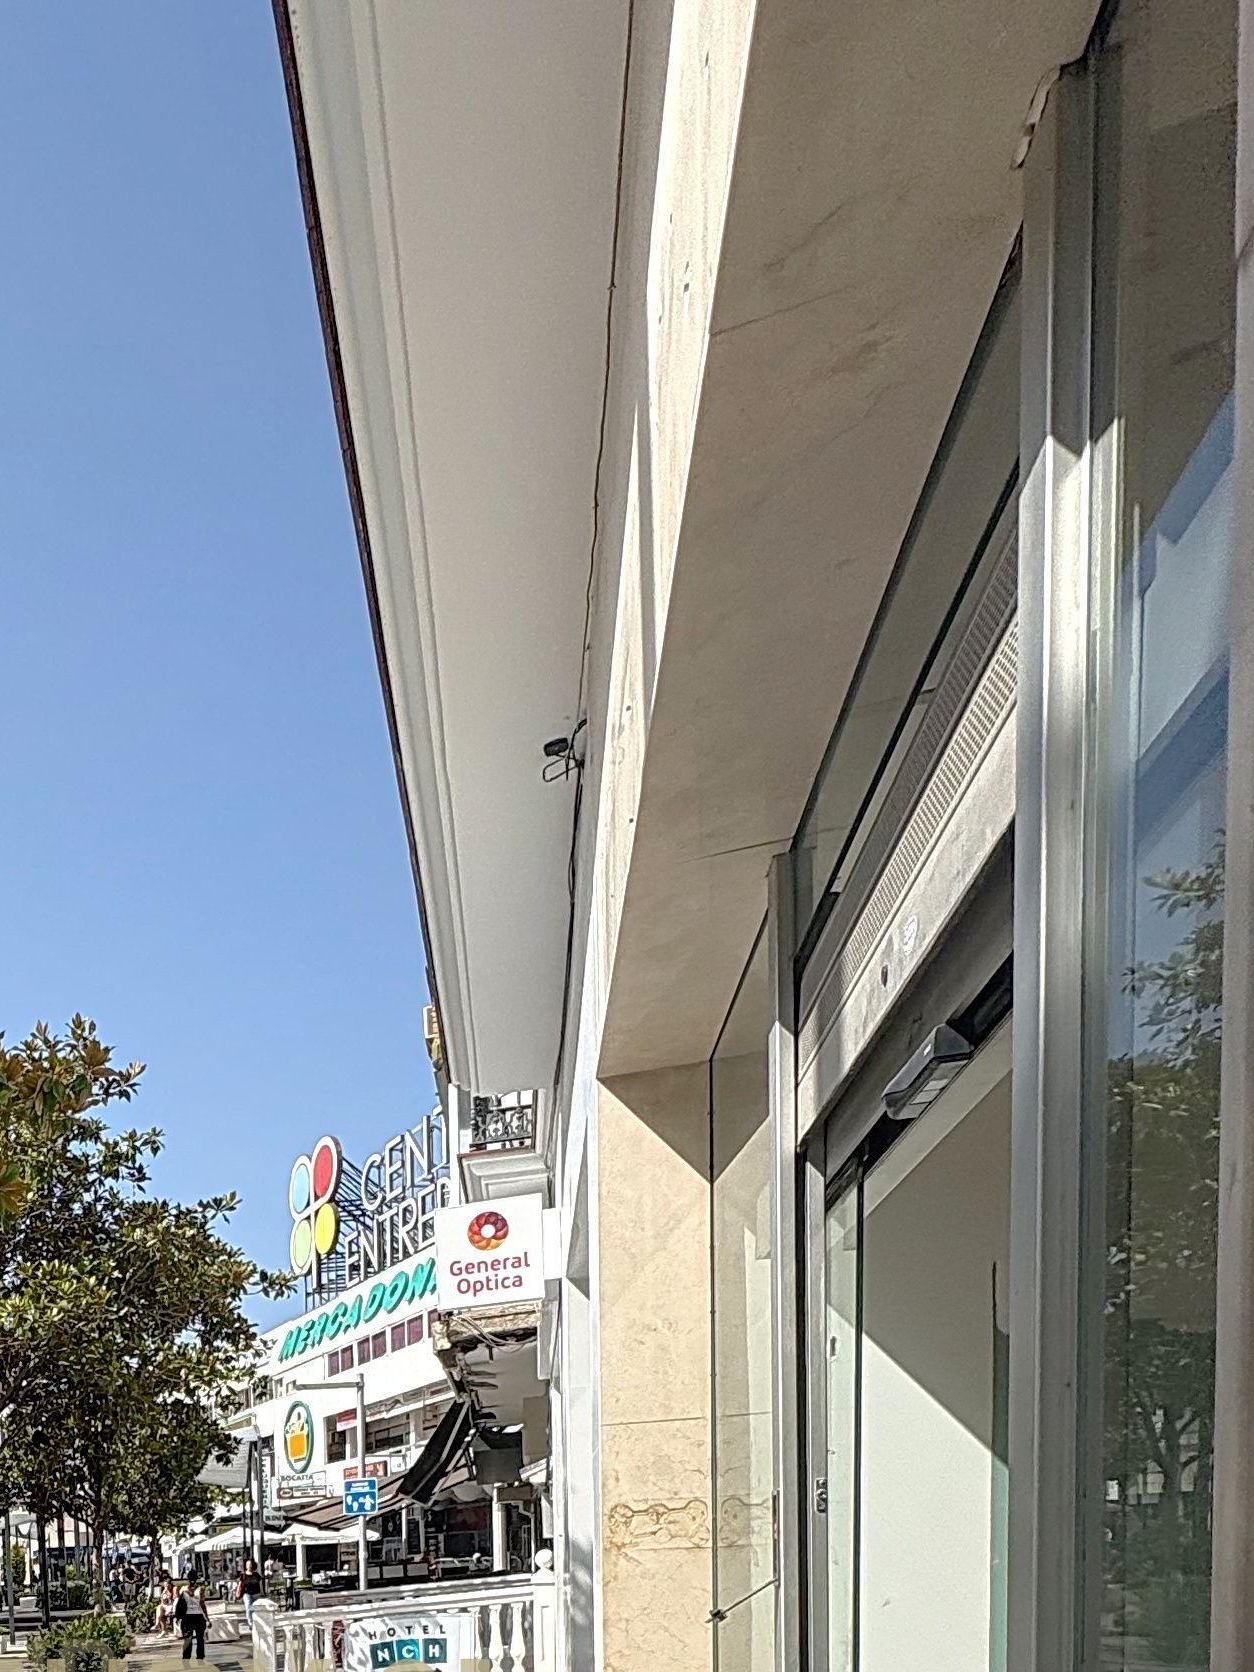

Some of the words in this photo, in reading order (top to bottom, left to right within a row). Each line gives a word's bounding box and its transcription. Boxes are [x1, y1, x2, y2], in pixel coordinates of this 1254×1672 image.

[449, 1251, 530, 1277] General
[456, 1273, 523, 1298] Optica
[278, 1257, 438, 1363] MERCADON
[368, 1624, 446, 1640] HOTEL
[376, 1644, 441, 1663] NCH
